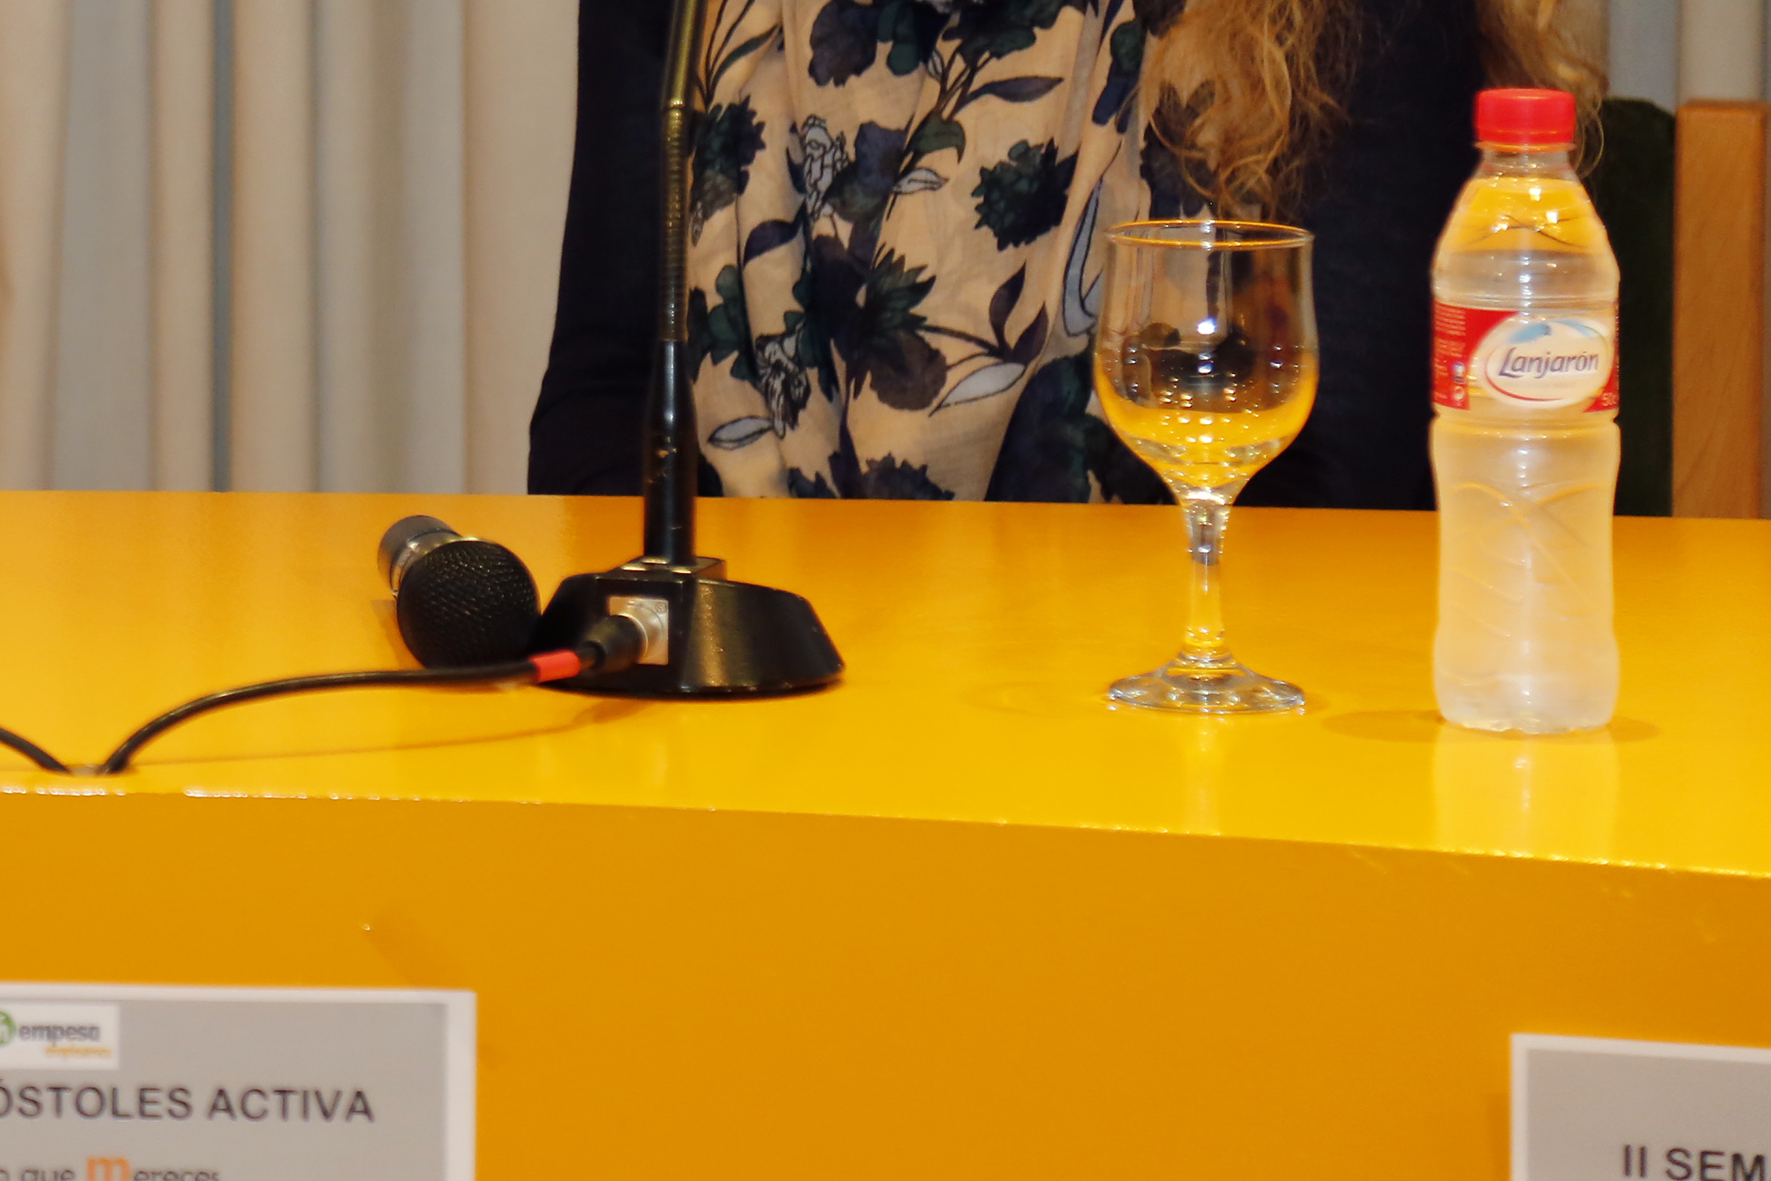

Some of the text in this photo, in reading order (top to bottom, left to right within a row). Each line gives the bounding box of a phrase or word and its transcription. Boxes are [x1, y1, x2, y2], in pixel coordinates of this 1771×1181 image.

[1499, 346, 1600, 379] Lanjarón
[18, 1025, 101, 1046] empesa
[207, 1087, 376, 1123] ACTIVA
[1623, 1143, 1647, 1179] II
